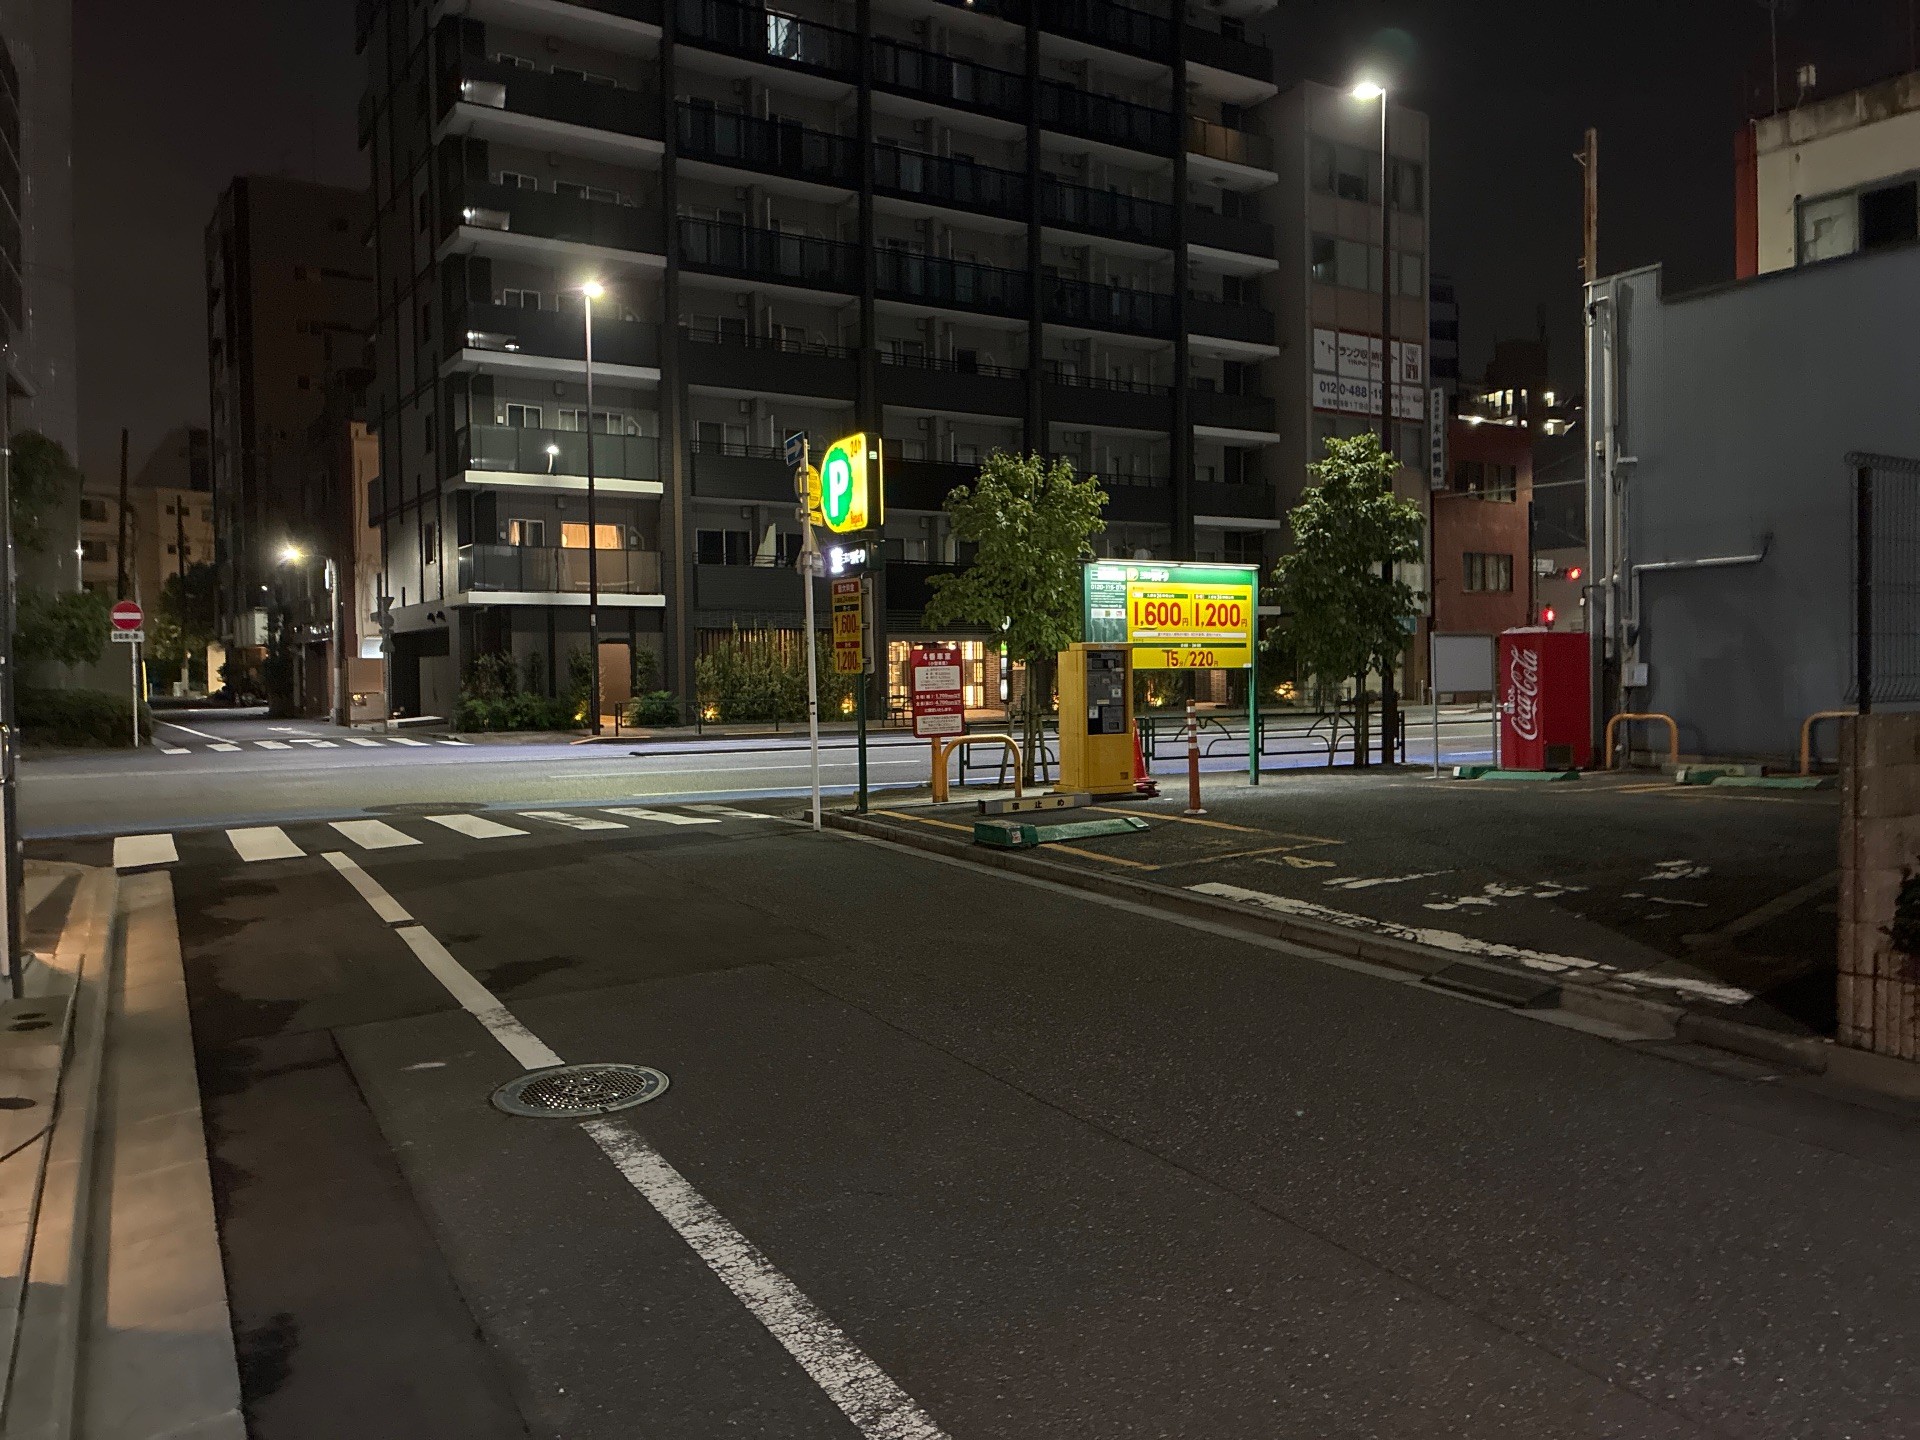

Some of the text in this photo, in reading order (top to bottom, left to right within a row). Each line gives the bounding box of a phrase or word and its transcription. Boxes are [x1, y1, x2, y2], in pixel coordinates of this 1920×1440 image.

[829, 460, 849, 517] P
[1012, 800, 1065, 811] 車止め
